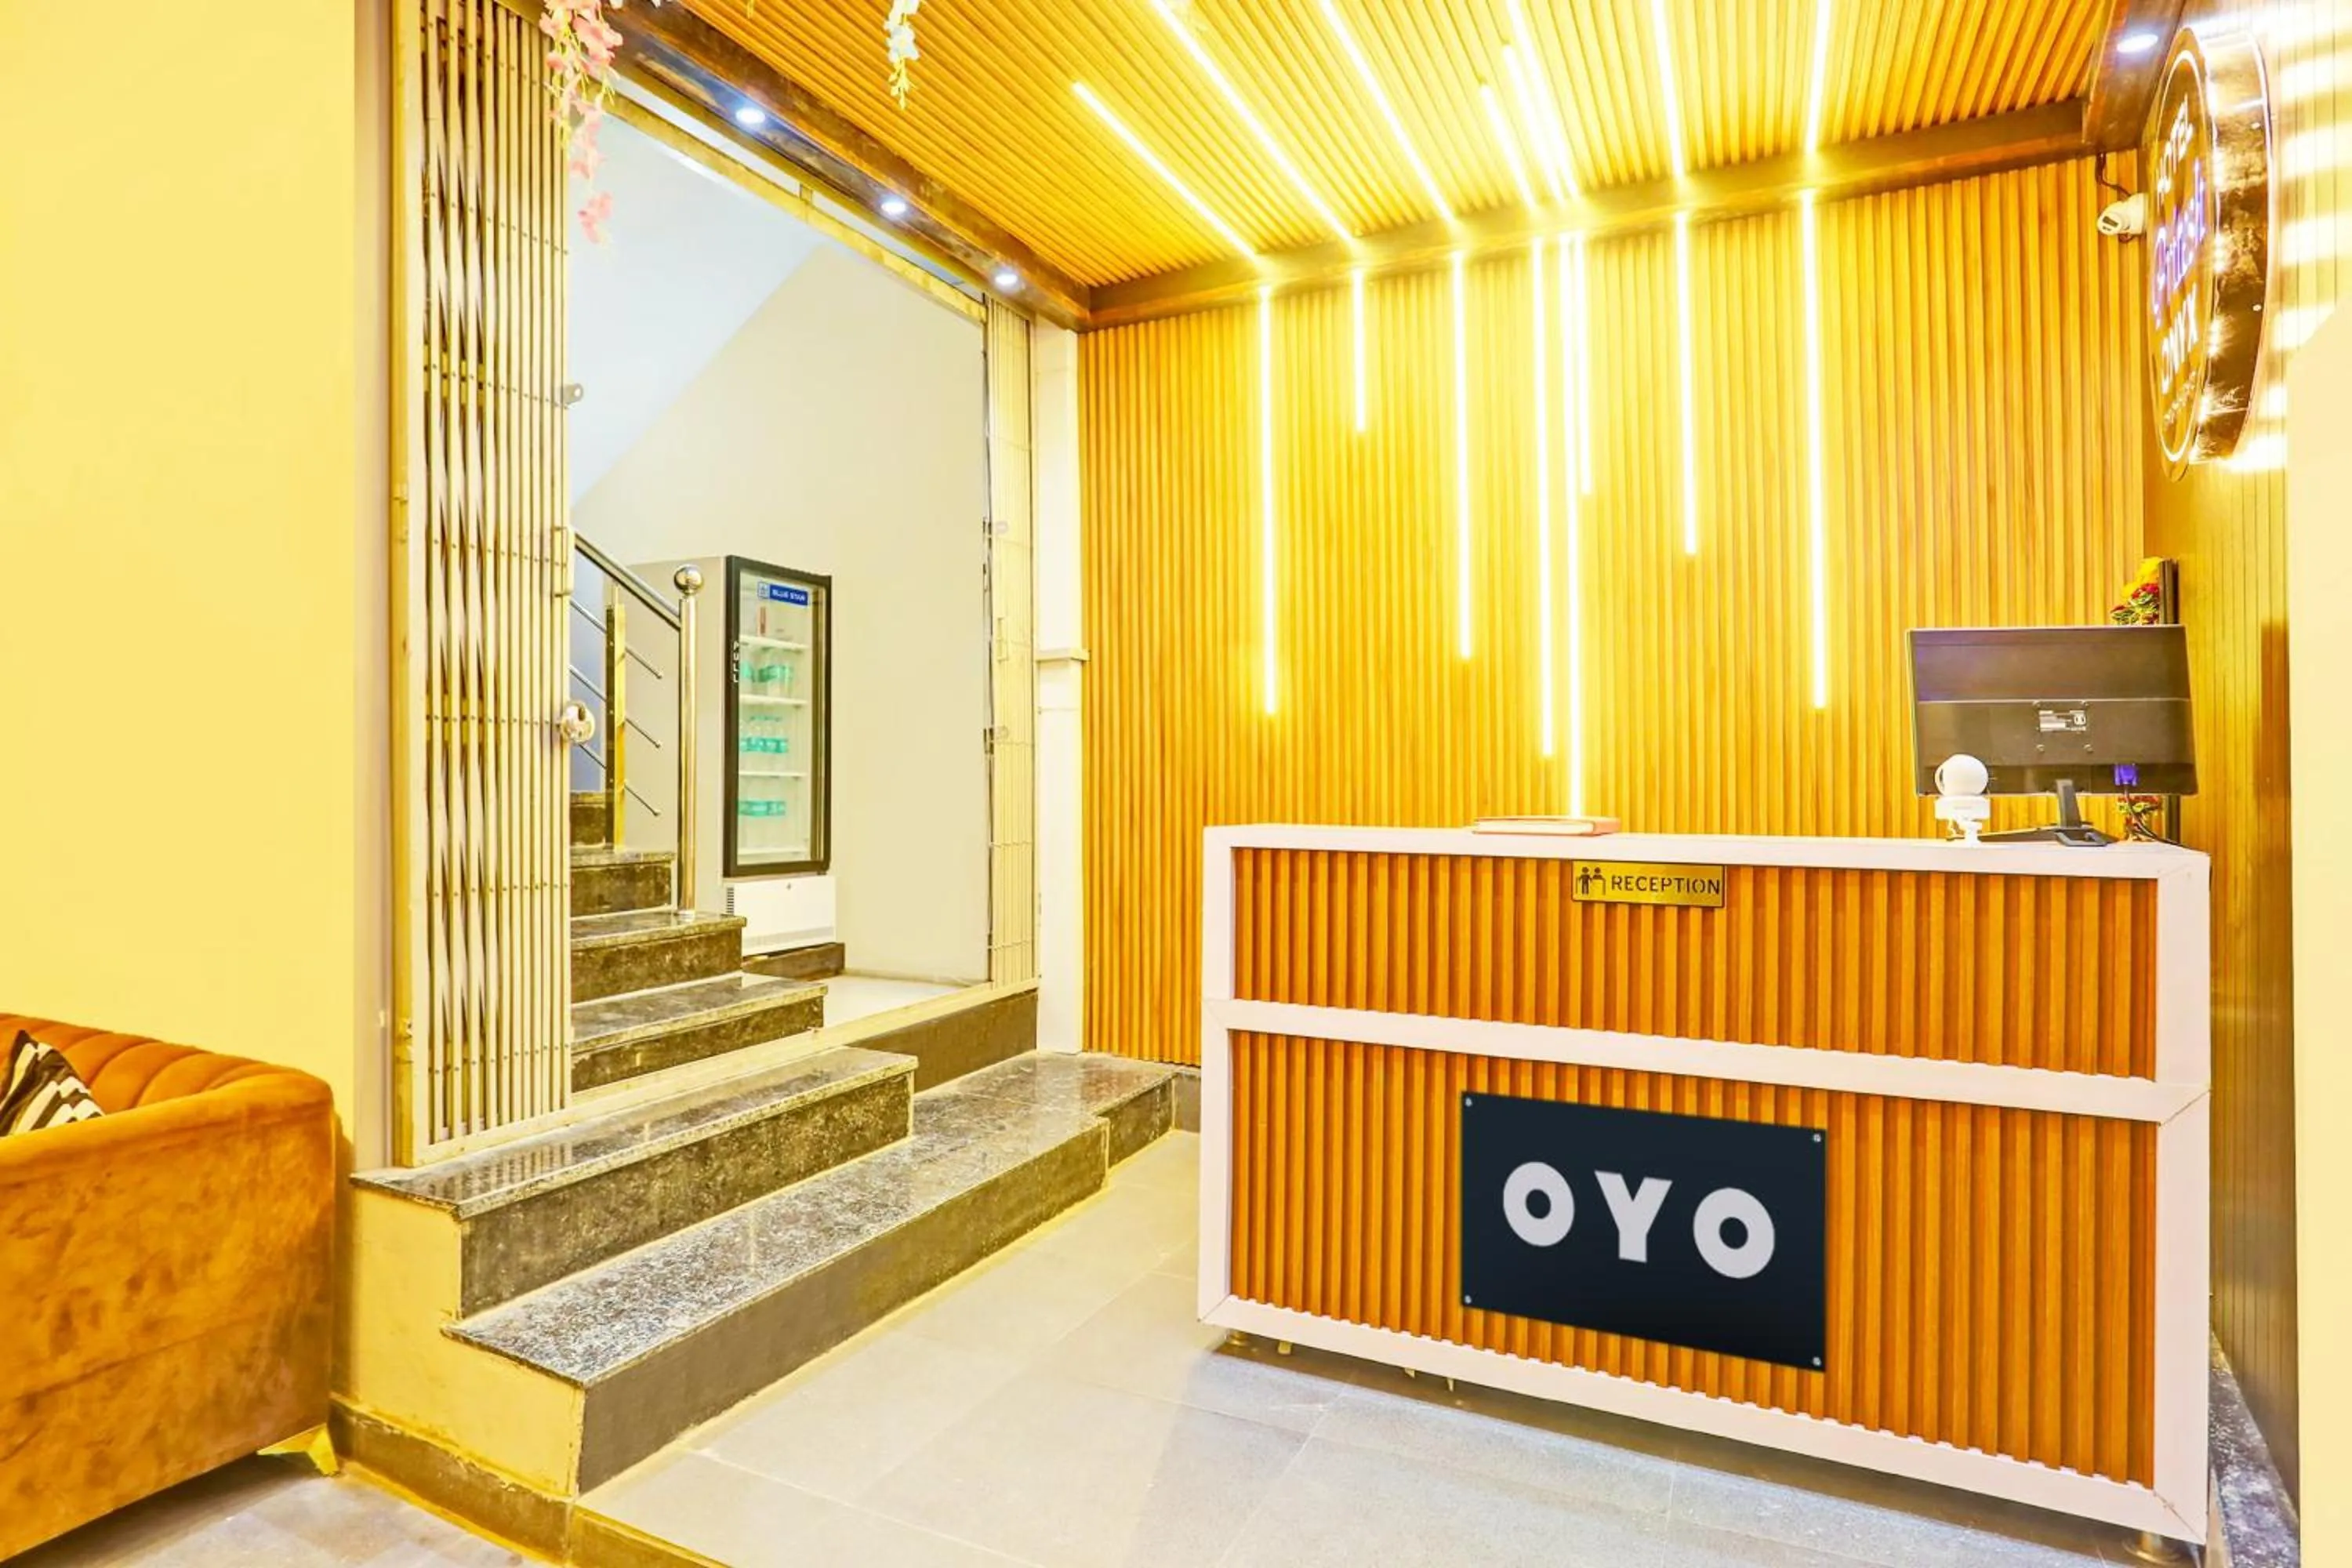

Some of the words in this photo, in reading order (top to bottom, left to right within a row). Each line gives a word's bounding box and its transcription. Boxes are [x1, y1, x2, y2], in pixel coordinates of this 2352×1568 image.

[772, 589, 789, 599] BLUE
[789, 592, 806, 601] STAR
[1611, 874, 1720, 895] RECEPTION
[1503, 1161, 1776, 1279] OYO
